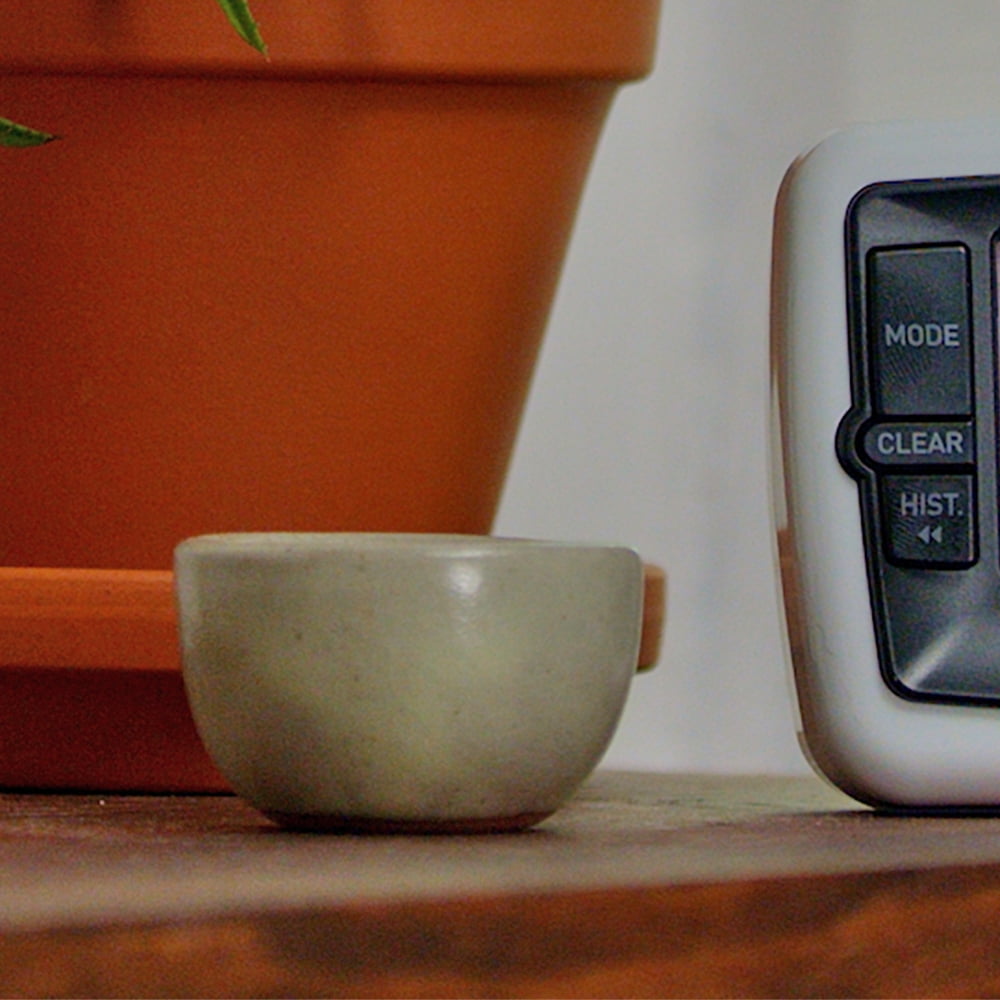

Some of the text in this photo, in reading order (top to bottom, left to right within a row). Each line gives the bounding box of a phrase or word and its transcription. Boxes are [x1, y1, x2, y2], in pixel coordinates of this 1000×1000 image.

[885, 323, 960, 347] MODE
[877, 432, 964, 454] CLEAR
[901, 492, 964, 517] HIST.
